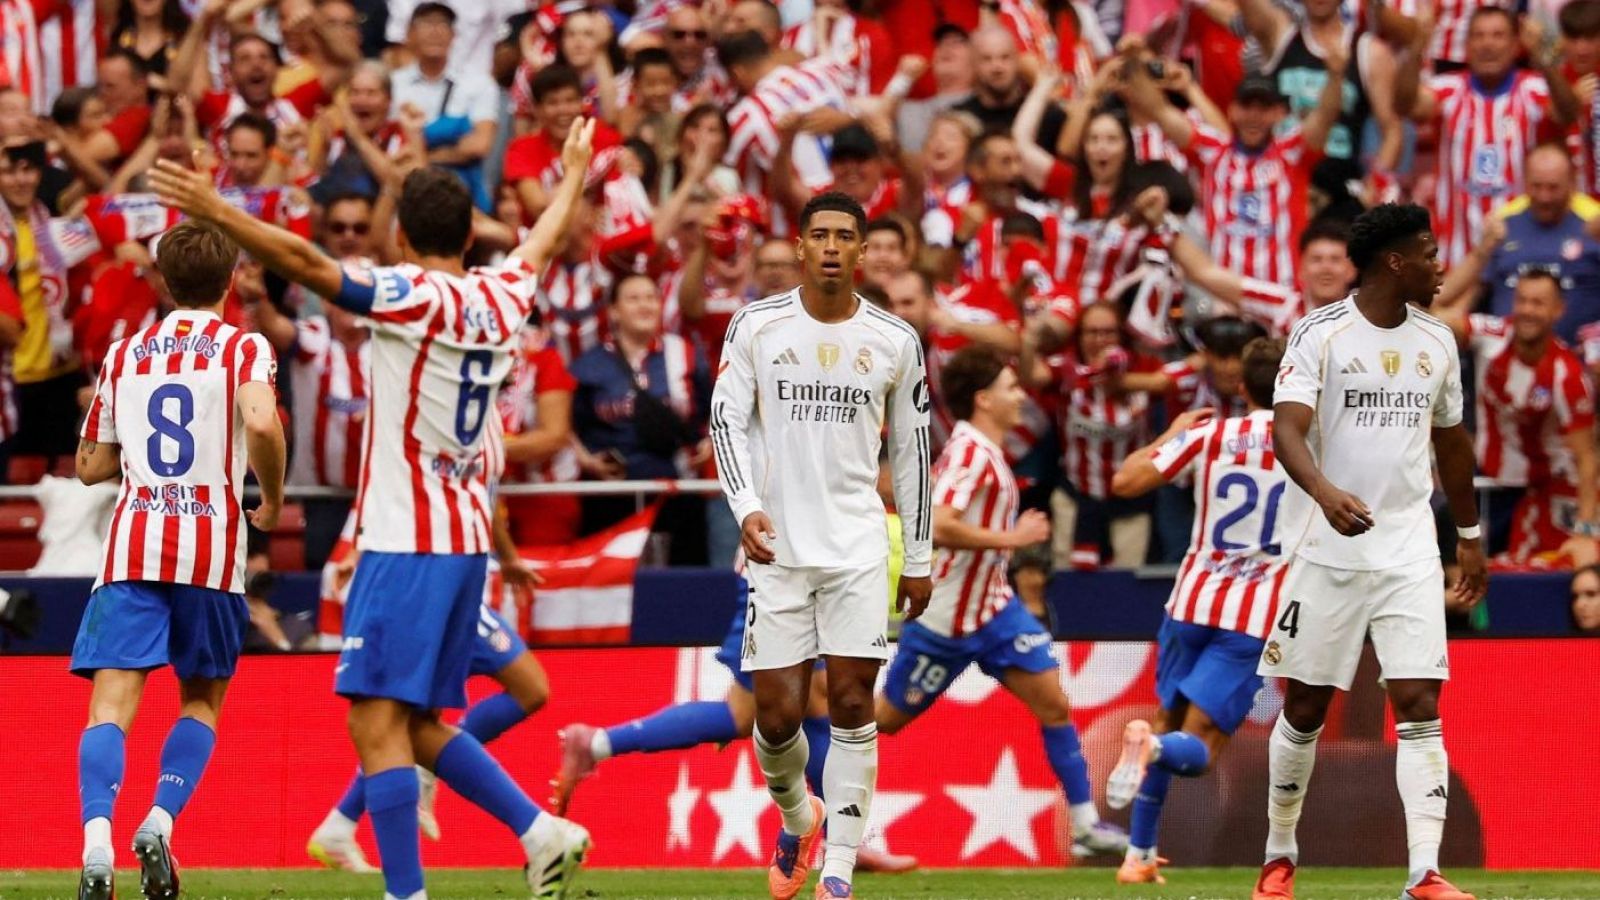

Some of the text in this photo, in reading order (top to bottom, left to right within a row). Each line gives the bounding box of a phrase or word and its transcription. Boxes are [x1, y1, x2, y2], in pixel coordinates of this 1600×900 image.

[133, 334, 220, 361] BARRIOS
[455, 350, 493, 446] 6
[777, 379, 872, 405] Emirates
[1344, 387, 1431, 409] Emirates
[791, 404, 857, 424] FLY BETTER
[1356, 411, 1421, 428] FLY BETTER
[147, 383, 195, 477] 8
[147, 484, 197, 501] VISIT
[130, 498, 217, 517] RWANDA
[1278, 600, 1301, 639] 4
[909, 654, 948, 693] 19
